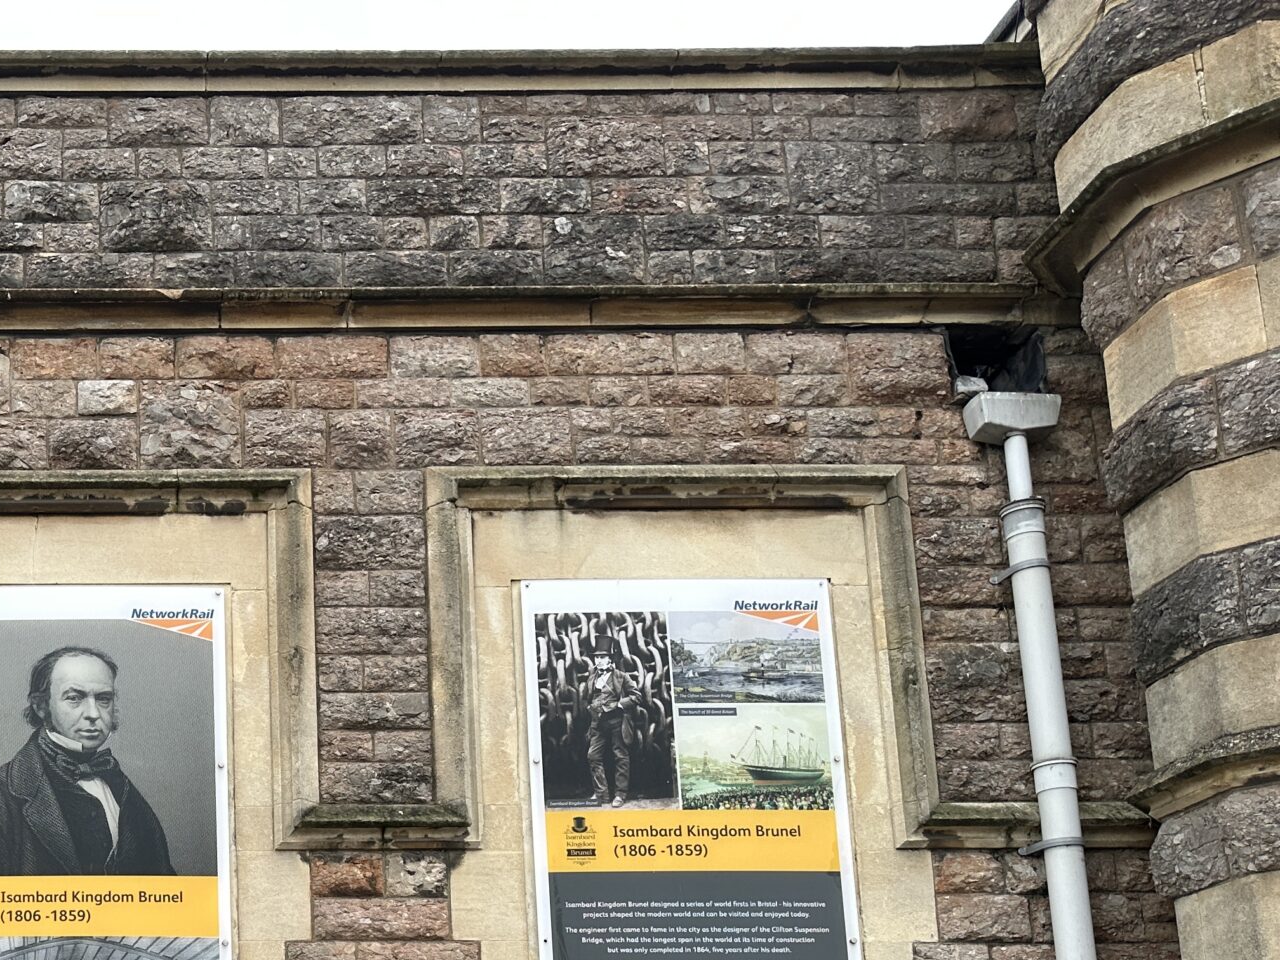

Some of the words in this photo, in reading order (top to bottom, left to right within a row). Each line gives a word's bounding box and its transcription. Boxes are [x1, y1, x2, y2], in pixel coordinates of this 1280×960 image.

[734, 600, 818, 610] NetworkRail
[131, 608, 214, 618] NetworkRail
[613, 826, 682, 838] Isambard
[687, 825, 752, 840] Kingdom
[756, 825, 801, 837] Brunel
[614, 844, 656, 858] (1806
[0, 891, 67, 903] Isambard
[72, 891, 134, 905] Kingdom
[138, 891, 183, 903] Brunel
[0, 910, 41, 923] (1806
[583, 911, 609, 919] projects
[610, 911, 634, 919] shaped
[765, 911, 790, 919] enjoyed
[791, 911, 810, 919] today.
